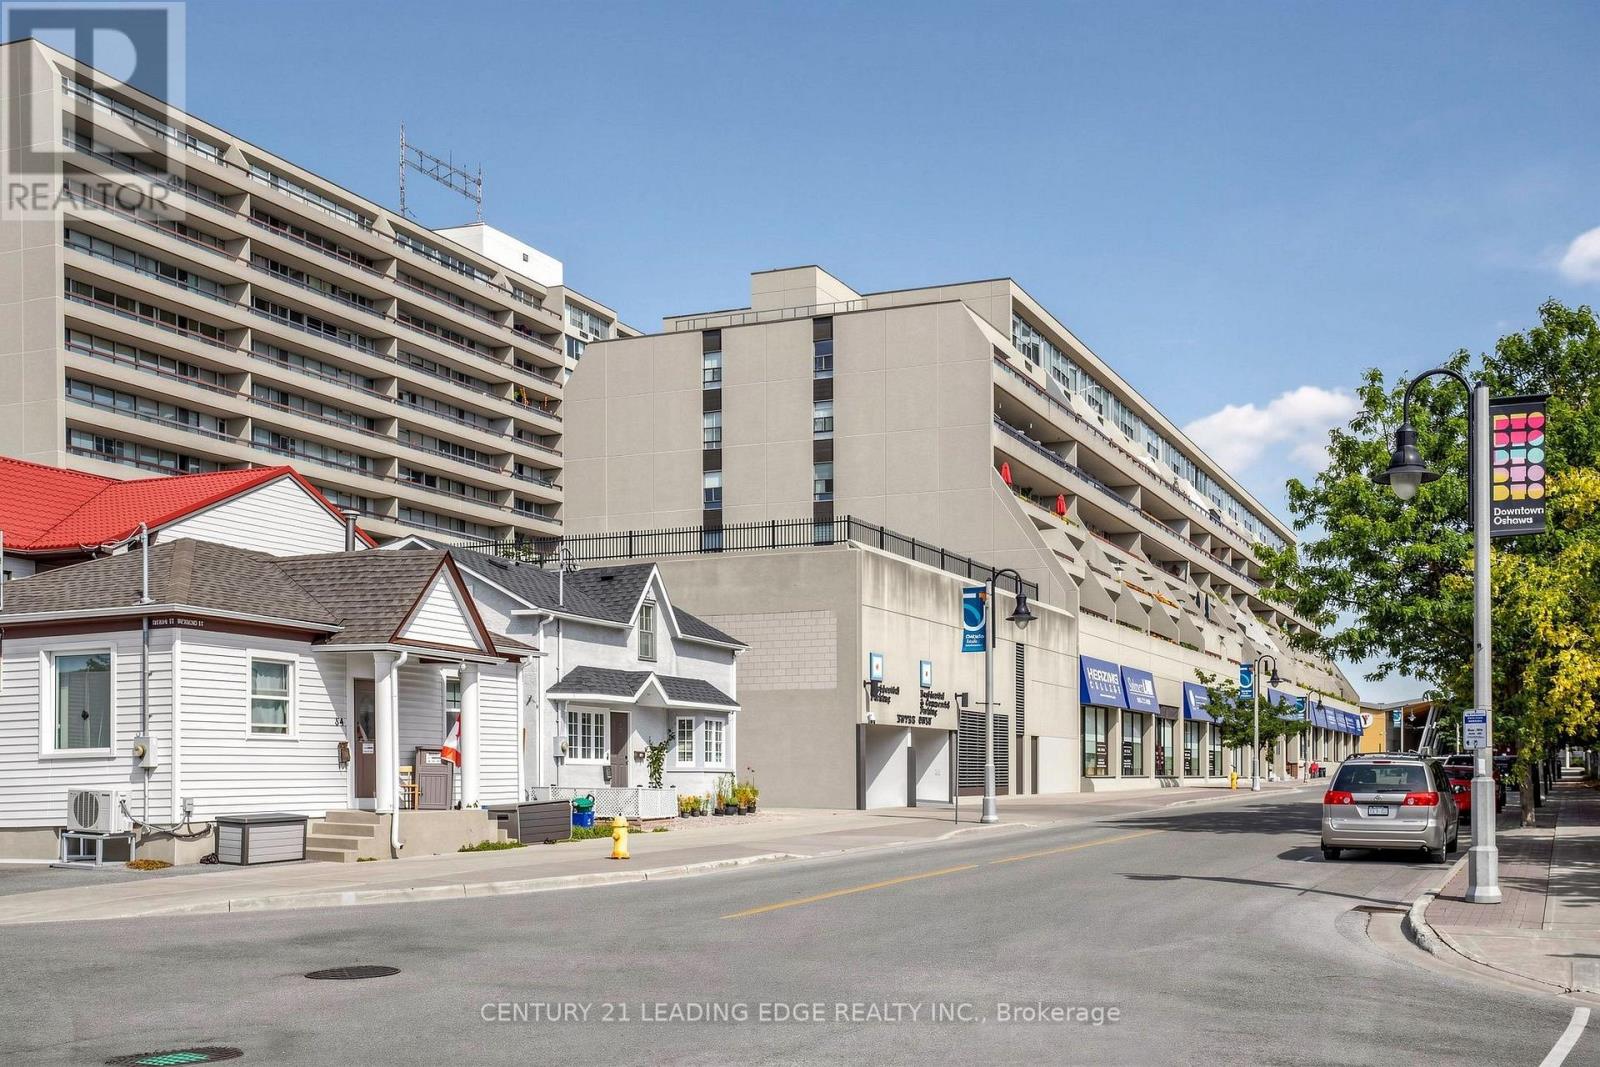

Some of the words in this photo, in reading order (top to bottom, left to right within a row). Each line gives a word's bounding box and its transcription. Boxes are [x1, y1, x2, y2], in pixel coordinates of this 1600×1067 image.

[1494, 506, 1544, 516] Downtown
[1494, 516, 1534, 525] Oshawa
[1086, 667, 1119, 685] HERZING
